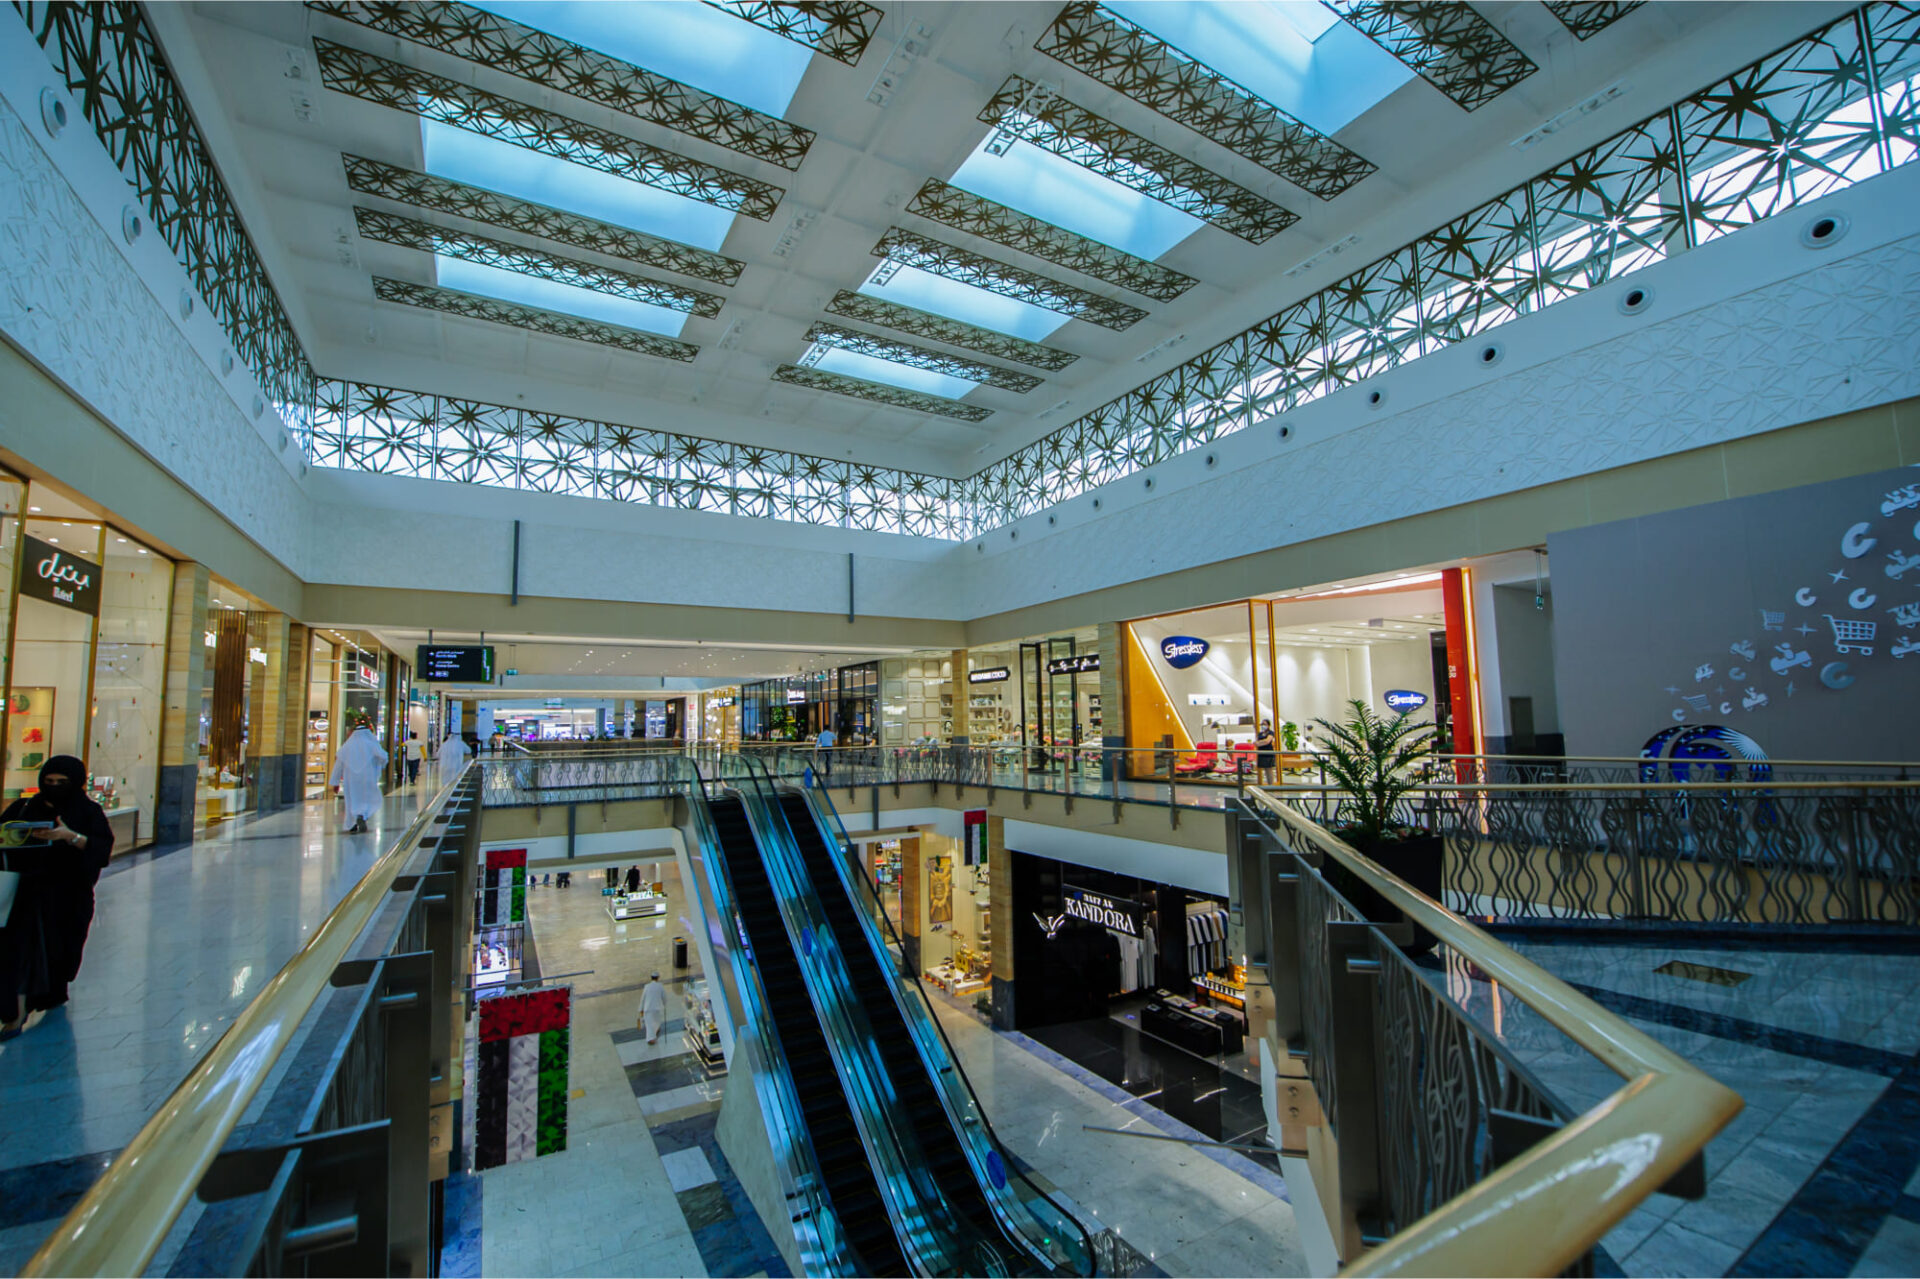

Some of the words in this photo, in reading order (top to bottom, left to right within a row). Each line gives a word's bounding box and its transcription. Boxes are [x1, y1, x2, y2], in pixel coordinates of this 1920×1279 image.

[38, 552, 90, 591] بتيل
[1164, 640, 1204, 659] Stressless
[1387, 693, 1425, 706] Stressless
[1064, 898, 1136, 934] KANDORA
